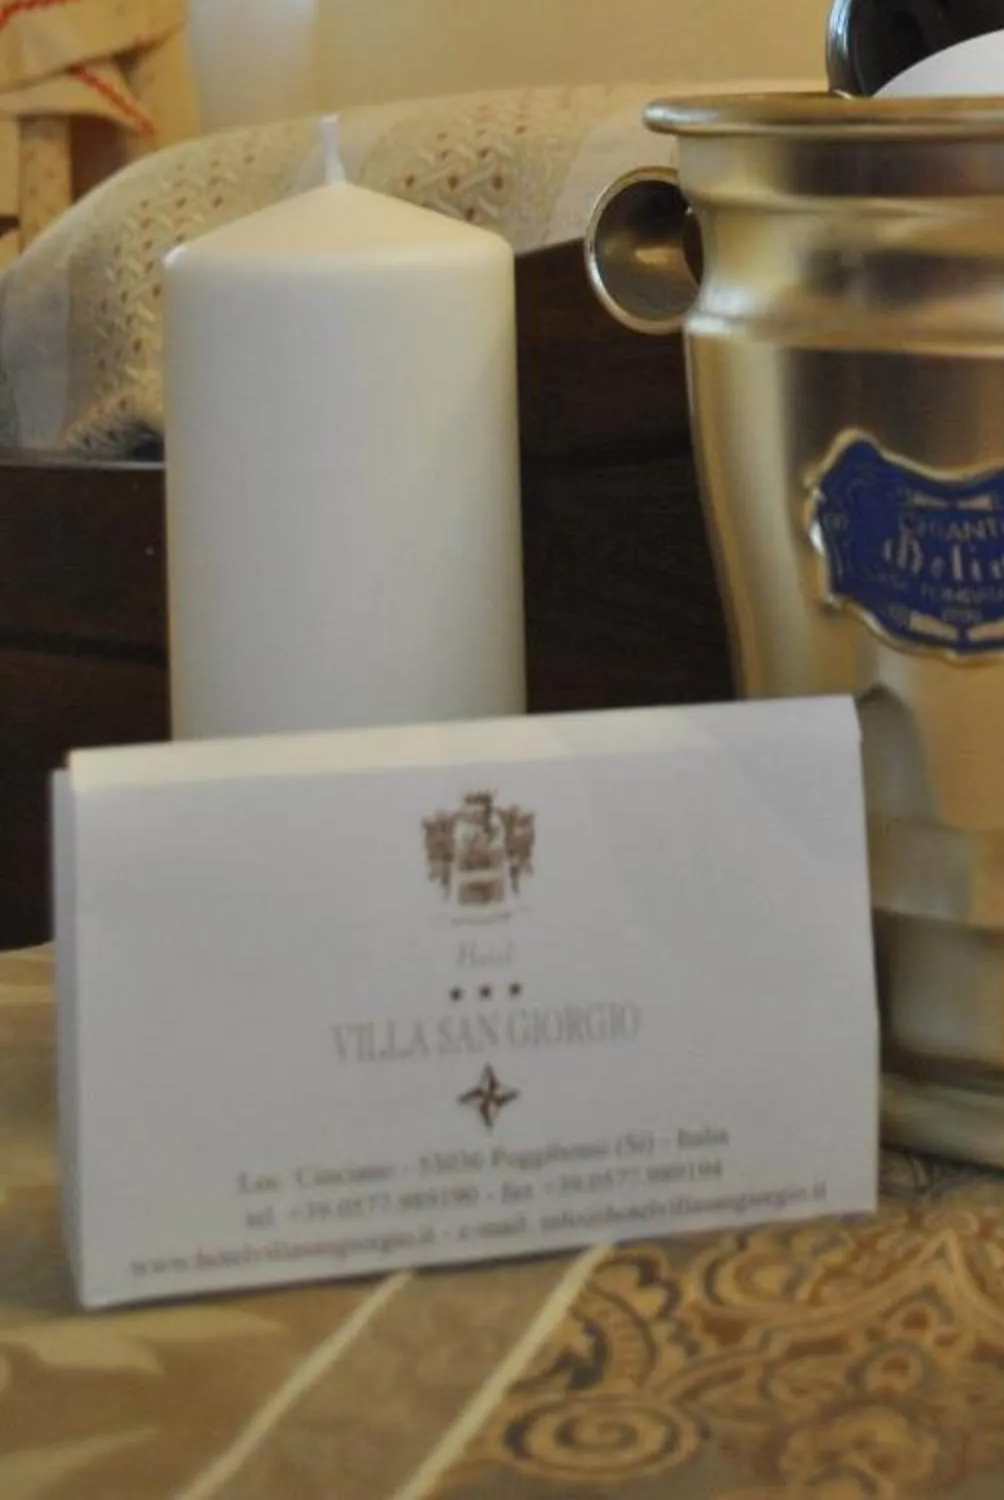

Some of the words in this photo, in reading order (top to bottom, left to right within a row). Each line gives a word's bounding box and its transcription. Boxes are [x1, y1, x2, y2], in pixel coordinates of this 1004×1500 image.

[332, 1019, 431, 1063] VILLA
[437, 1009, 500, 1055] SAN
[505, 999, 643, 1049] GIORGIO
